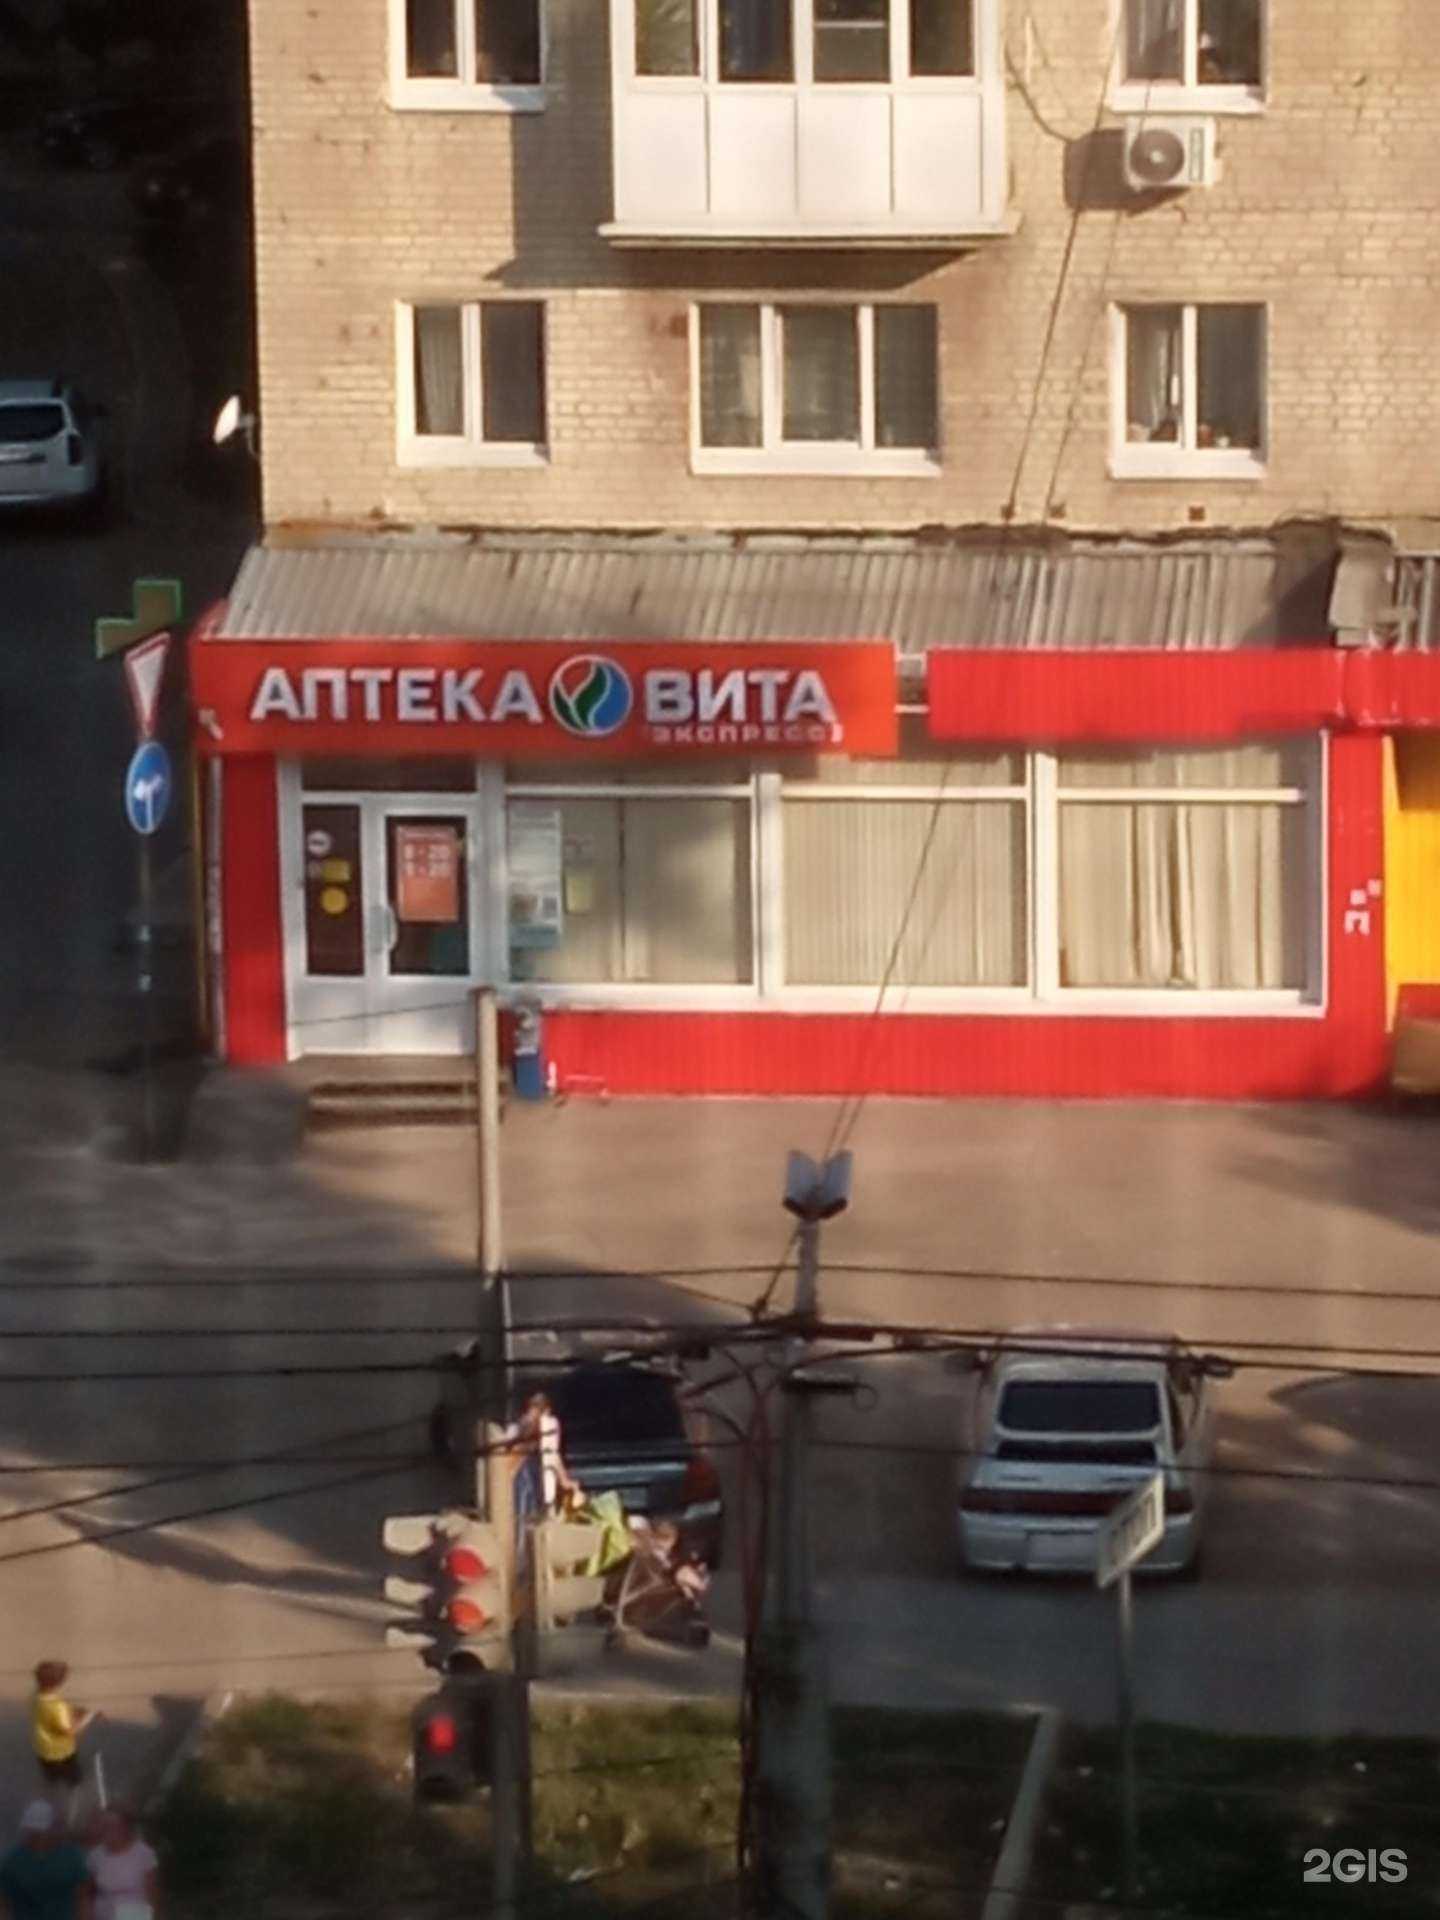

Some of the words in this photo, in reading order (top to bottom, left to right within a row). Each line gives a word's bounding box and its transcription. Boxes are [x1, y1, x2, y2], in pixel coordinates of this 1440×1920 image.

[249, 667, 544, 723] АПТЕКА
[645, 669, 838, 723] ВИТА
[652, 723, 829, 743] ЭКСПРЕСС
